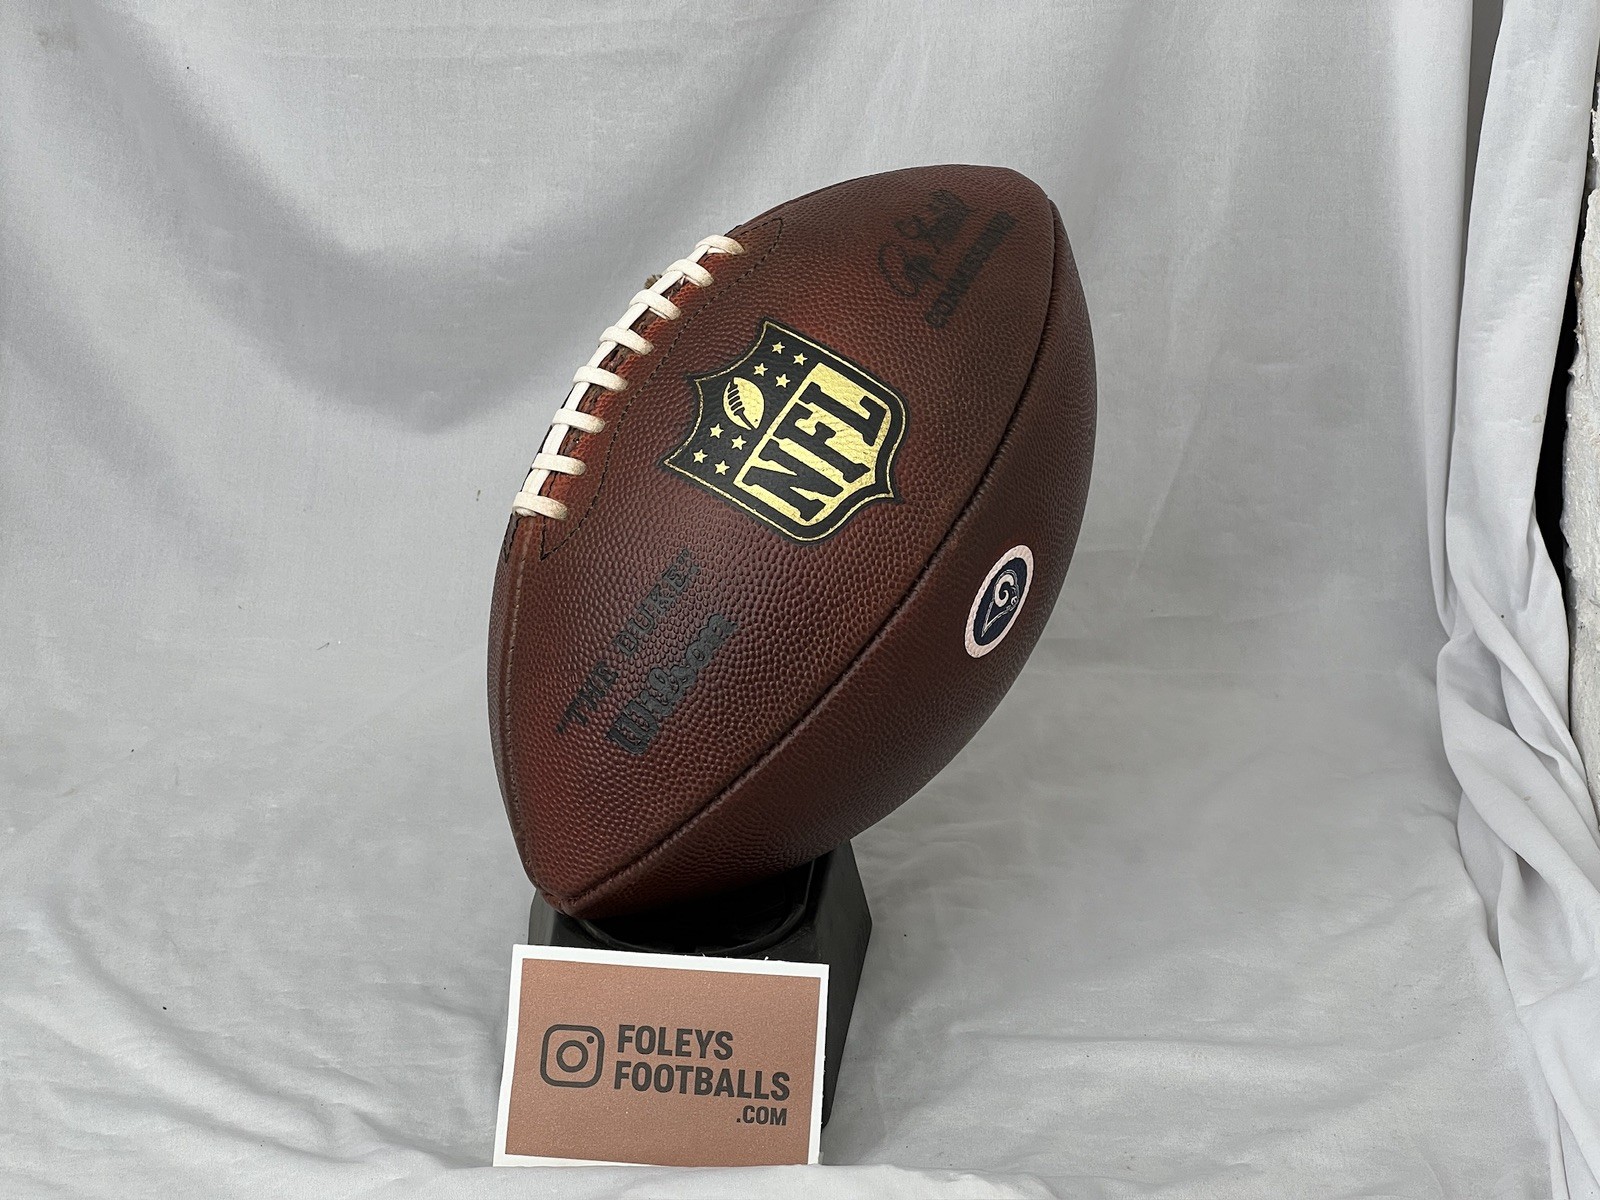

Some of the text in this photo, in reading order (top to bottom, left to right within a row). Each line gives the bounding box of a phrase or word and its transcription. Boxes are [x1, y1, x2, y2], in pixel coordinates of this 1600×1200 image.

[740, 380, 889, 523] NFL
[605, 613, 738, 755] Wilson
[617, 1024, 734, 1061] FOLEYS
[613, 1060, 790, 1101] FOOTBALLS
[736, 1105, 788, 1126] .COM
